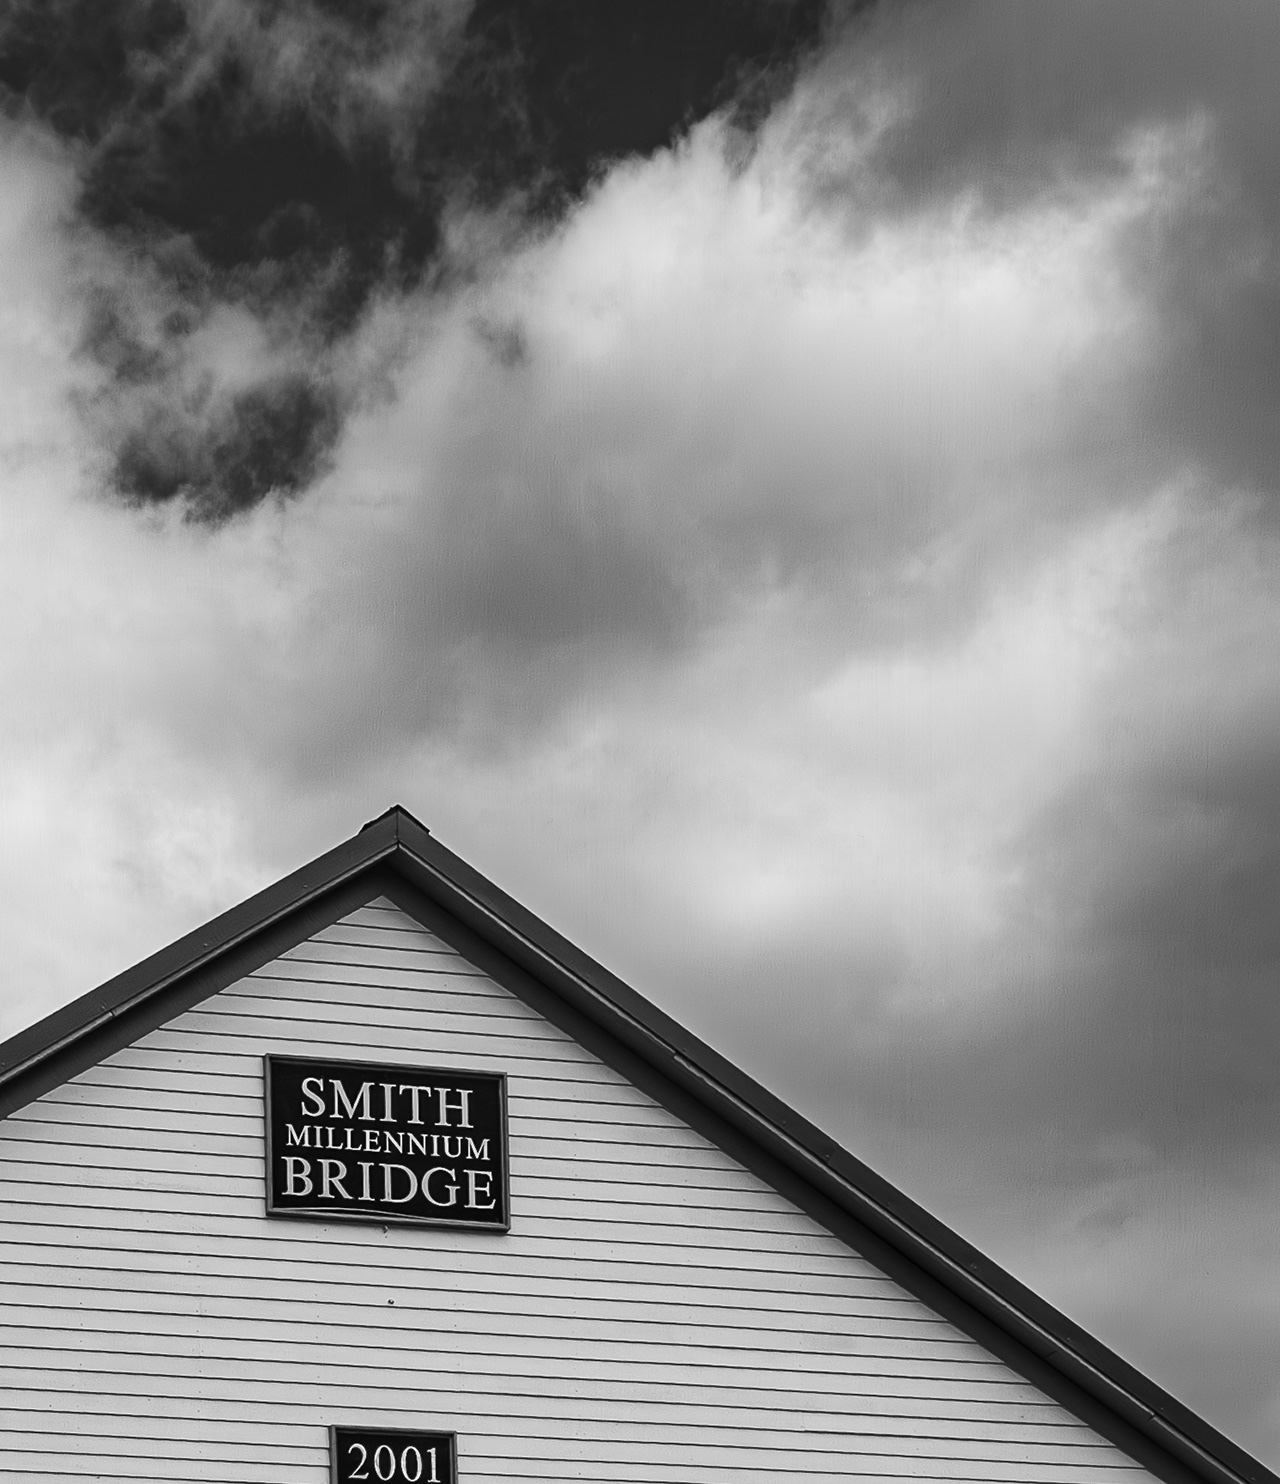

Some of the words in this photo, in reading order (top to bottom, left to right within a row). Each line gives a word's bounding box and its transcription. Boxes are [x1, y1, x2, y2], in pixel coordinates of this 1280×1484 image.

[301, 1076, 474, 1129] SMITH
[285, 1123, 490, 1161] MILLENNIUM
[281, 1156, 496, 1210] BRIDGE
[348, 1443, 441, 1483] 2001
